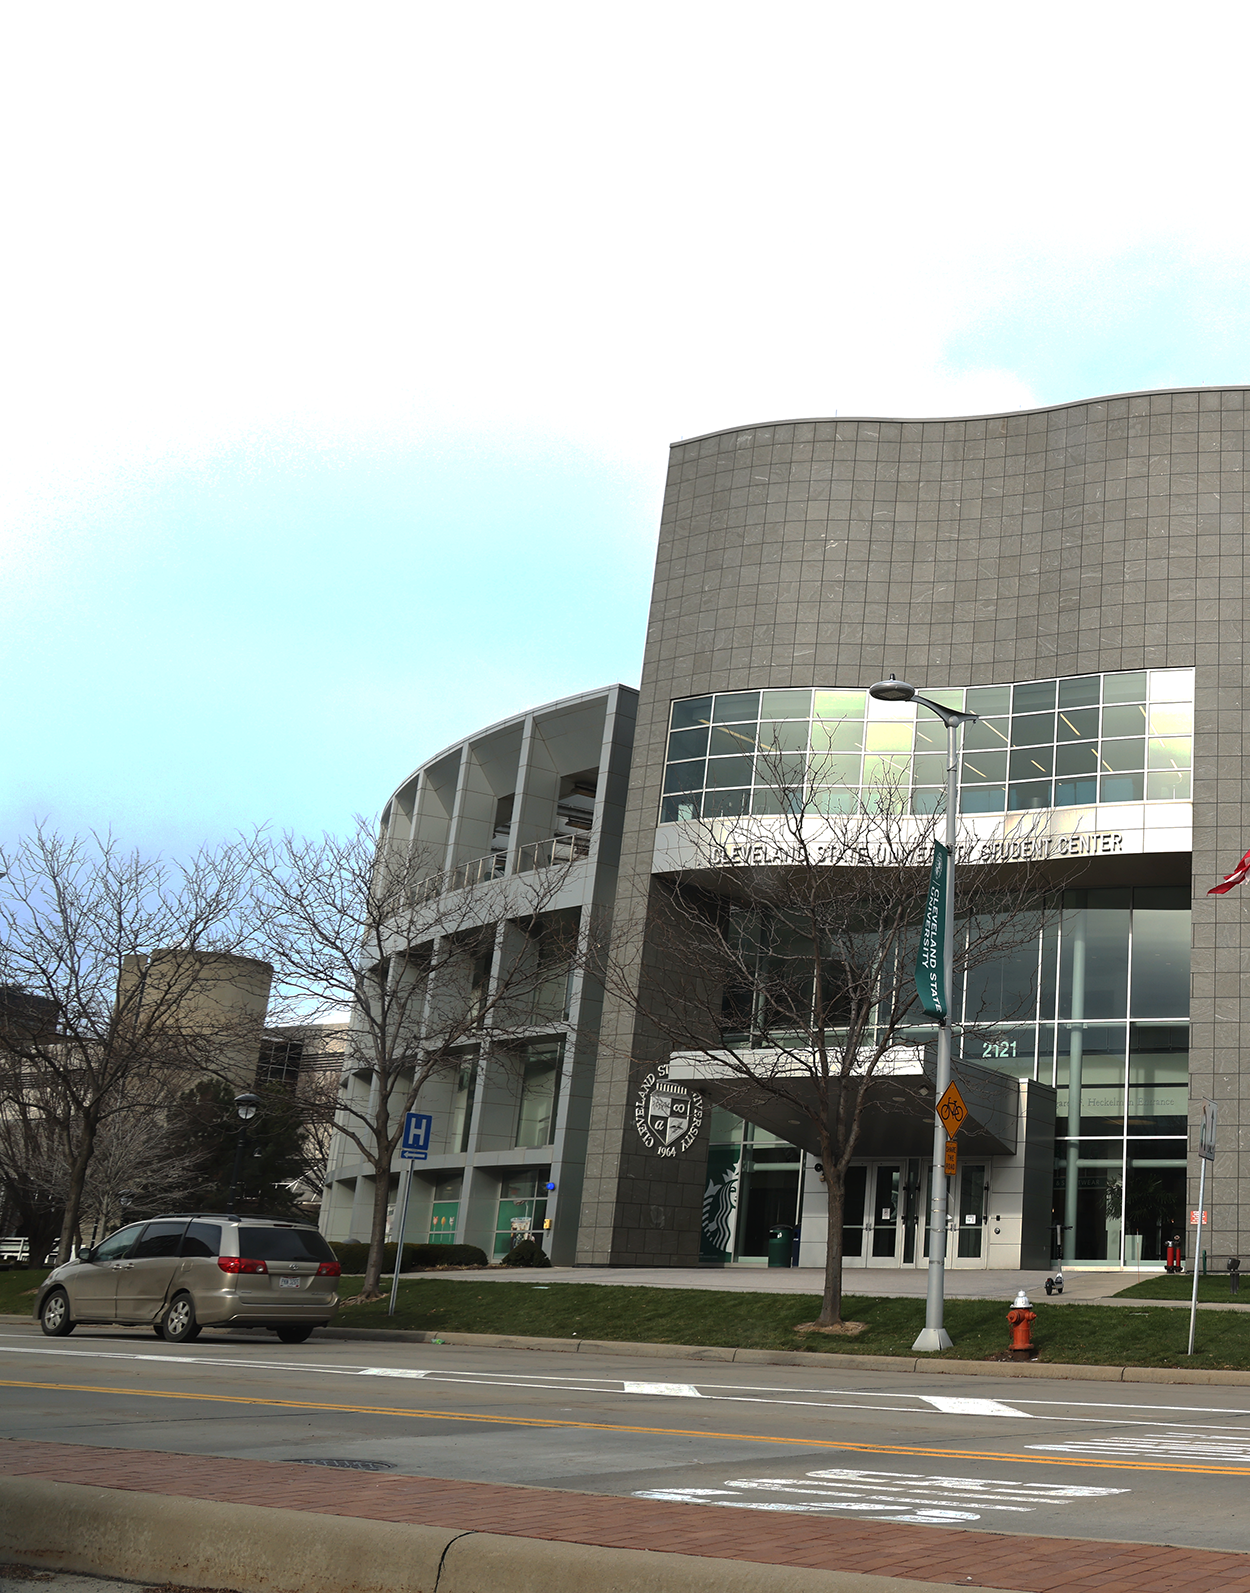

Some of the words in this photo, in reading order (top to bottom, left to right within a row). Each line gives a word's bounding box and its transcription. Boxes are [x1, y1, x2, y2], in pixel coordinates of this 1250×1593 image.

[981, 838, 1052, 862] STUDENT
[1058, 833, 1123, 855] CENTER
[921, 886, 934, 968] UNIVERSITY
[929, 888, 940, 968] CLEVELAND
[929, 972, 942, 1012] STATE
[982, 1040, 1017, 1058] 2121
[635, 1073, 656, 1148] CLEVELAND
[408, 1117, 427, 1146] H
[657, 1146, 677, 1158] 1964
